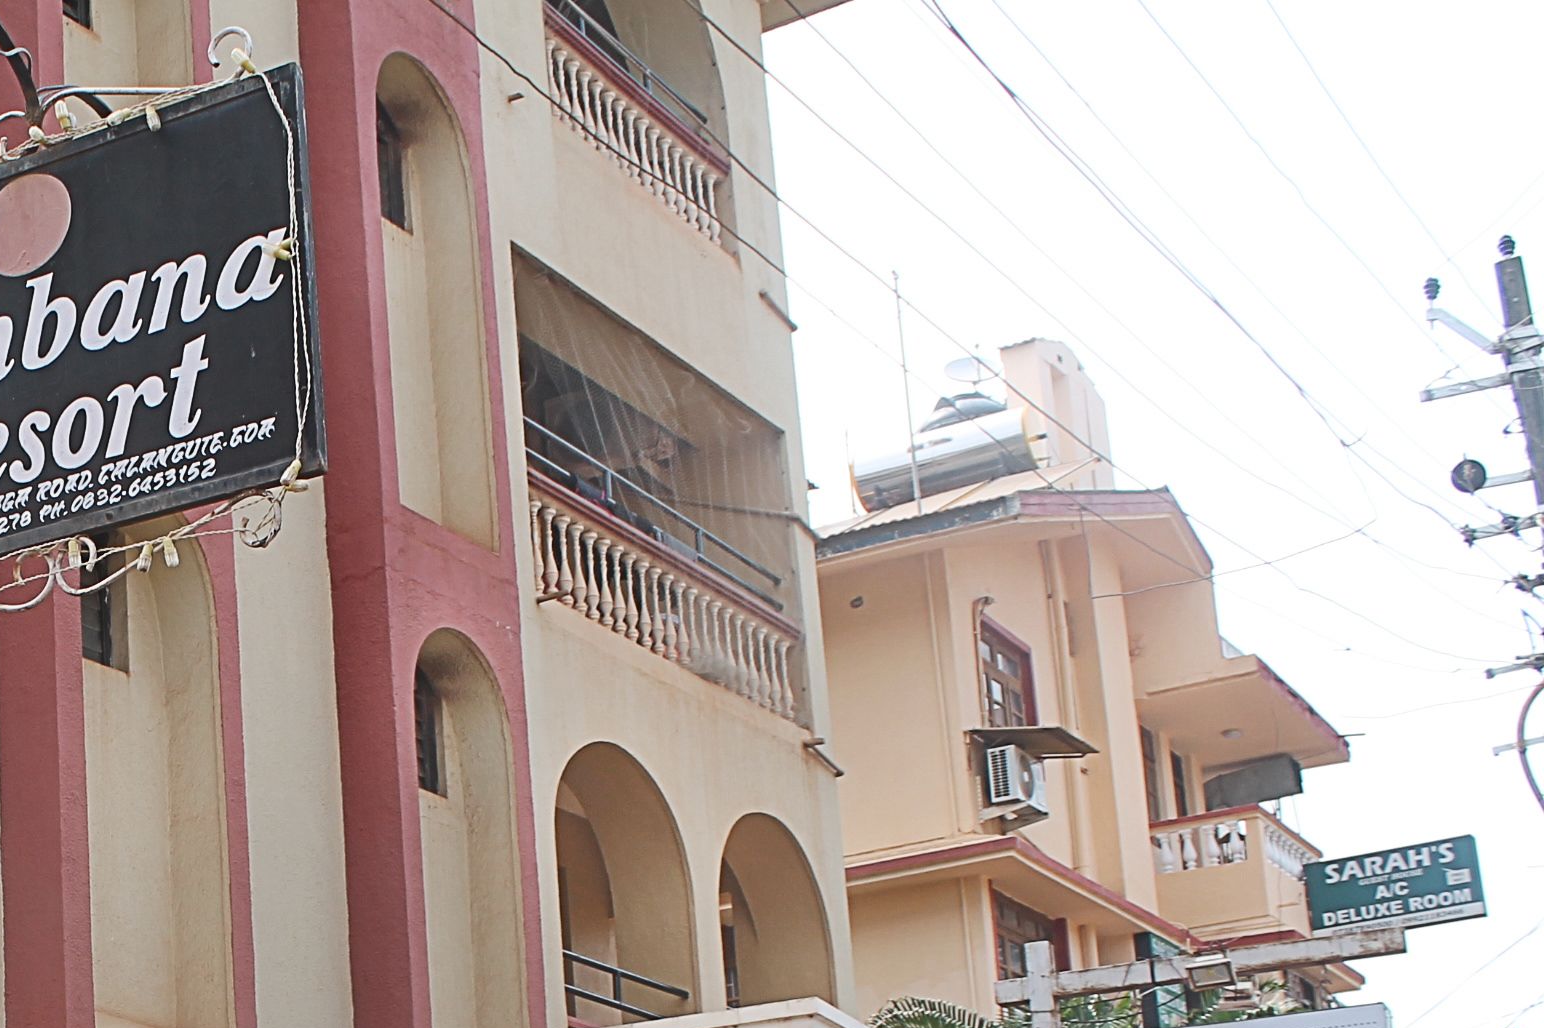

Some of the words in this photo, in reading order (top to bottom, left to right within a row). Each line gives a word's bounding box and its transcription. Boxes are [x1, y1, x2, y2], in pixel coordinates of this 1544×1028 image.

[1324, 842, 1457, 885] SARAH'S
[1321, 899, 1405, 927] DELUXE
[1407, 888, 1473, 912] ROOM
[1374, 881, 1410, 900] A/C
